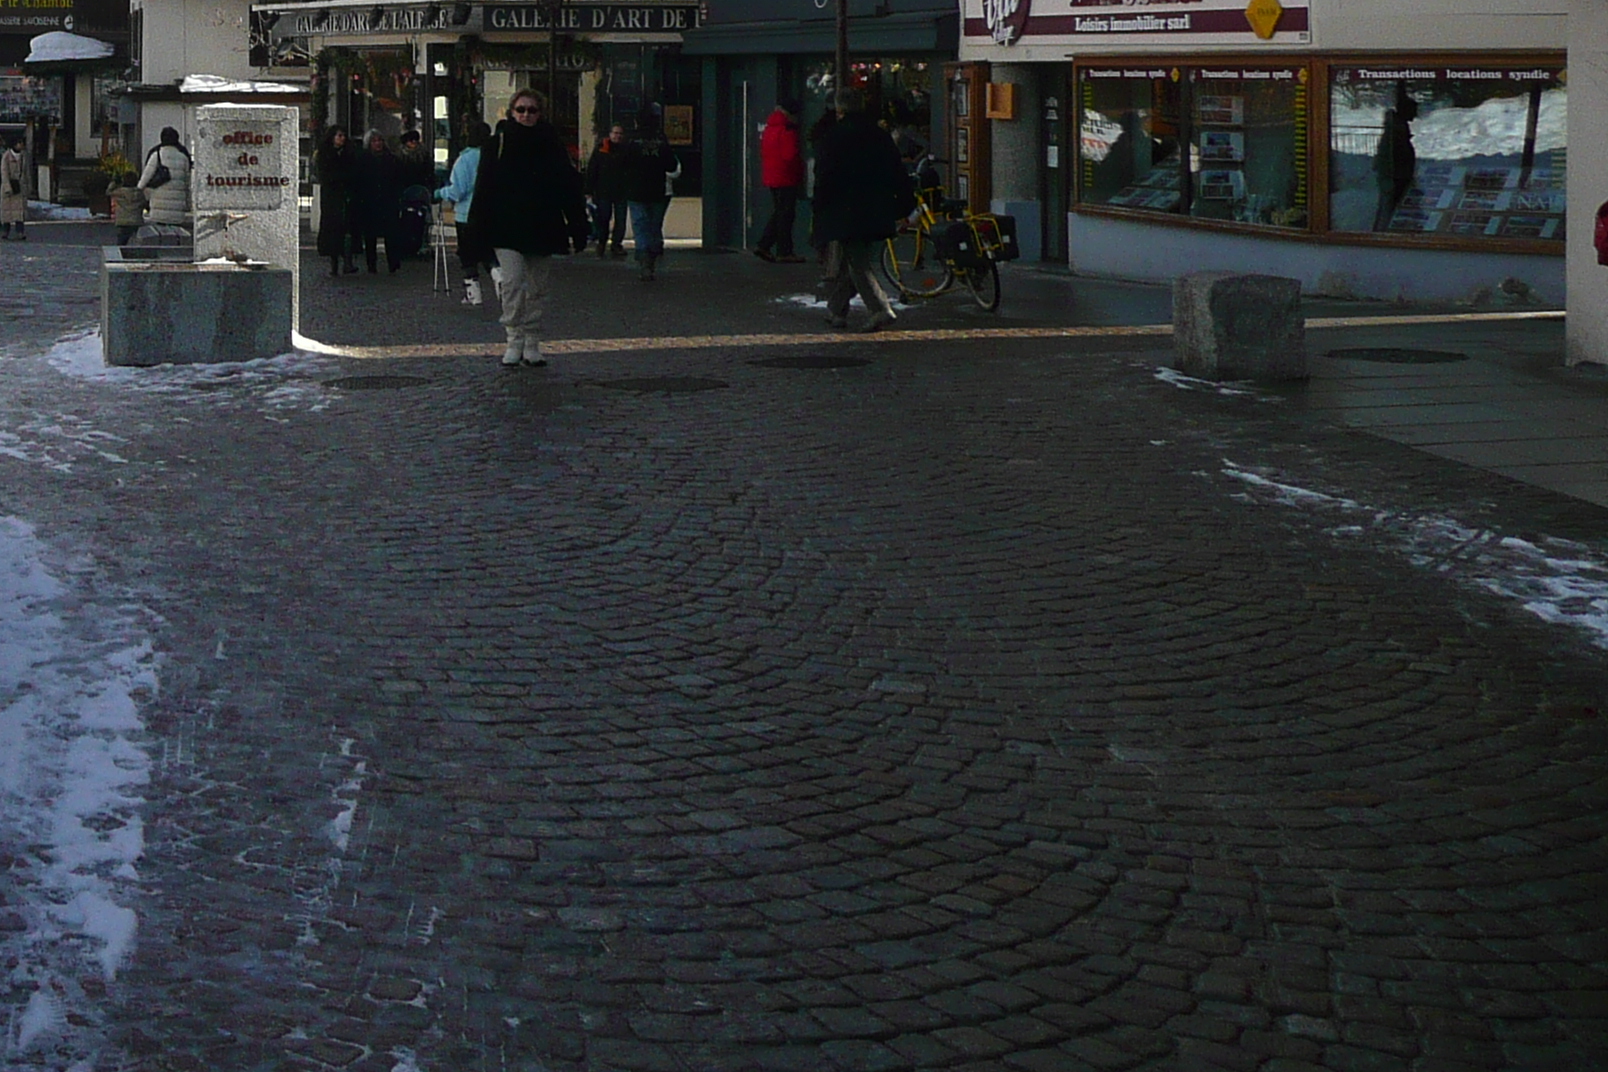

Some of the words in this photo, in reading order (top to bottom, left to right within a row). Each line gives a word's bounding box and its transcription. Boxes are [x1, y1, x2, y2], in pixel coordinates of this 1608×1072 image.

[296, 14, 339, 33] GALRIE
[392, 9, 447, 30] L'ALPGE
[492, 7, 581, 28] GALEIE
[592, 6, 654, 28] D'ART
[662, 8, 687, 28] DE
[1075, 16, 1109, 32] Loisirs
[1109, 15, 1166, 31] immobilier
[1167, 14, 1190, 29] sarl
[1358, 69, 1436, 79] Transactions
[1446, 69, 1502, 79] locations
[222, 131, 273, 145] office
[237, 152, 258, 166] de
[206, 173, 290, 187] tourisme
